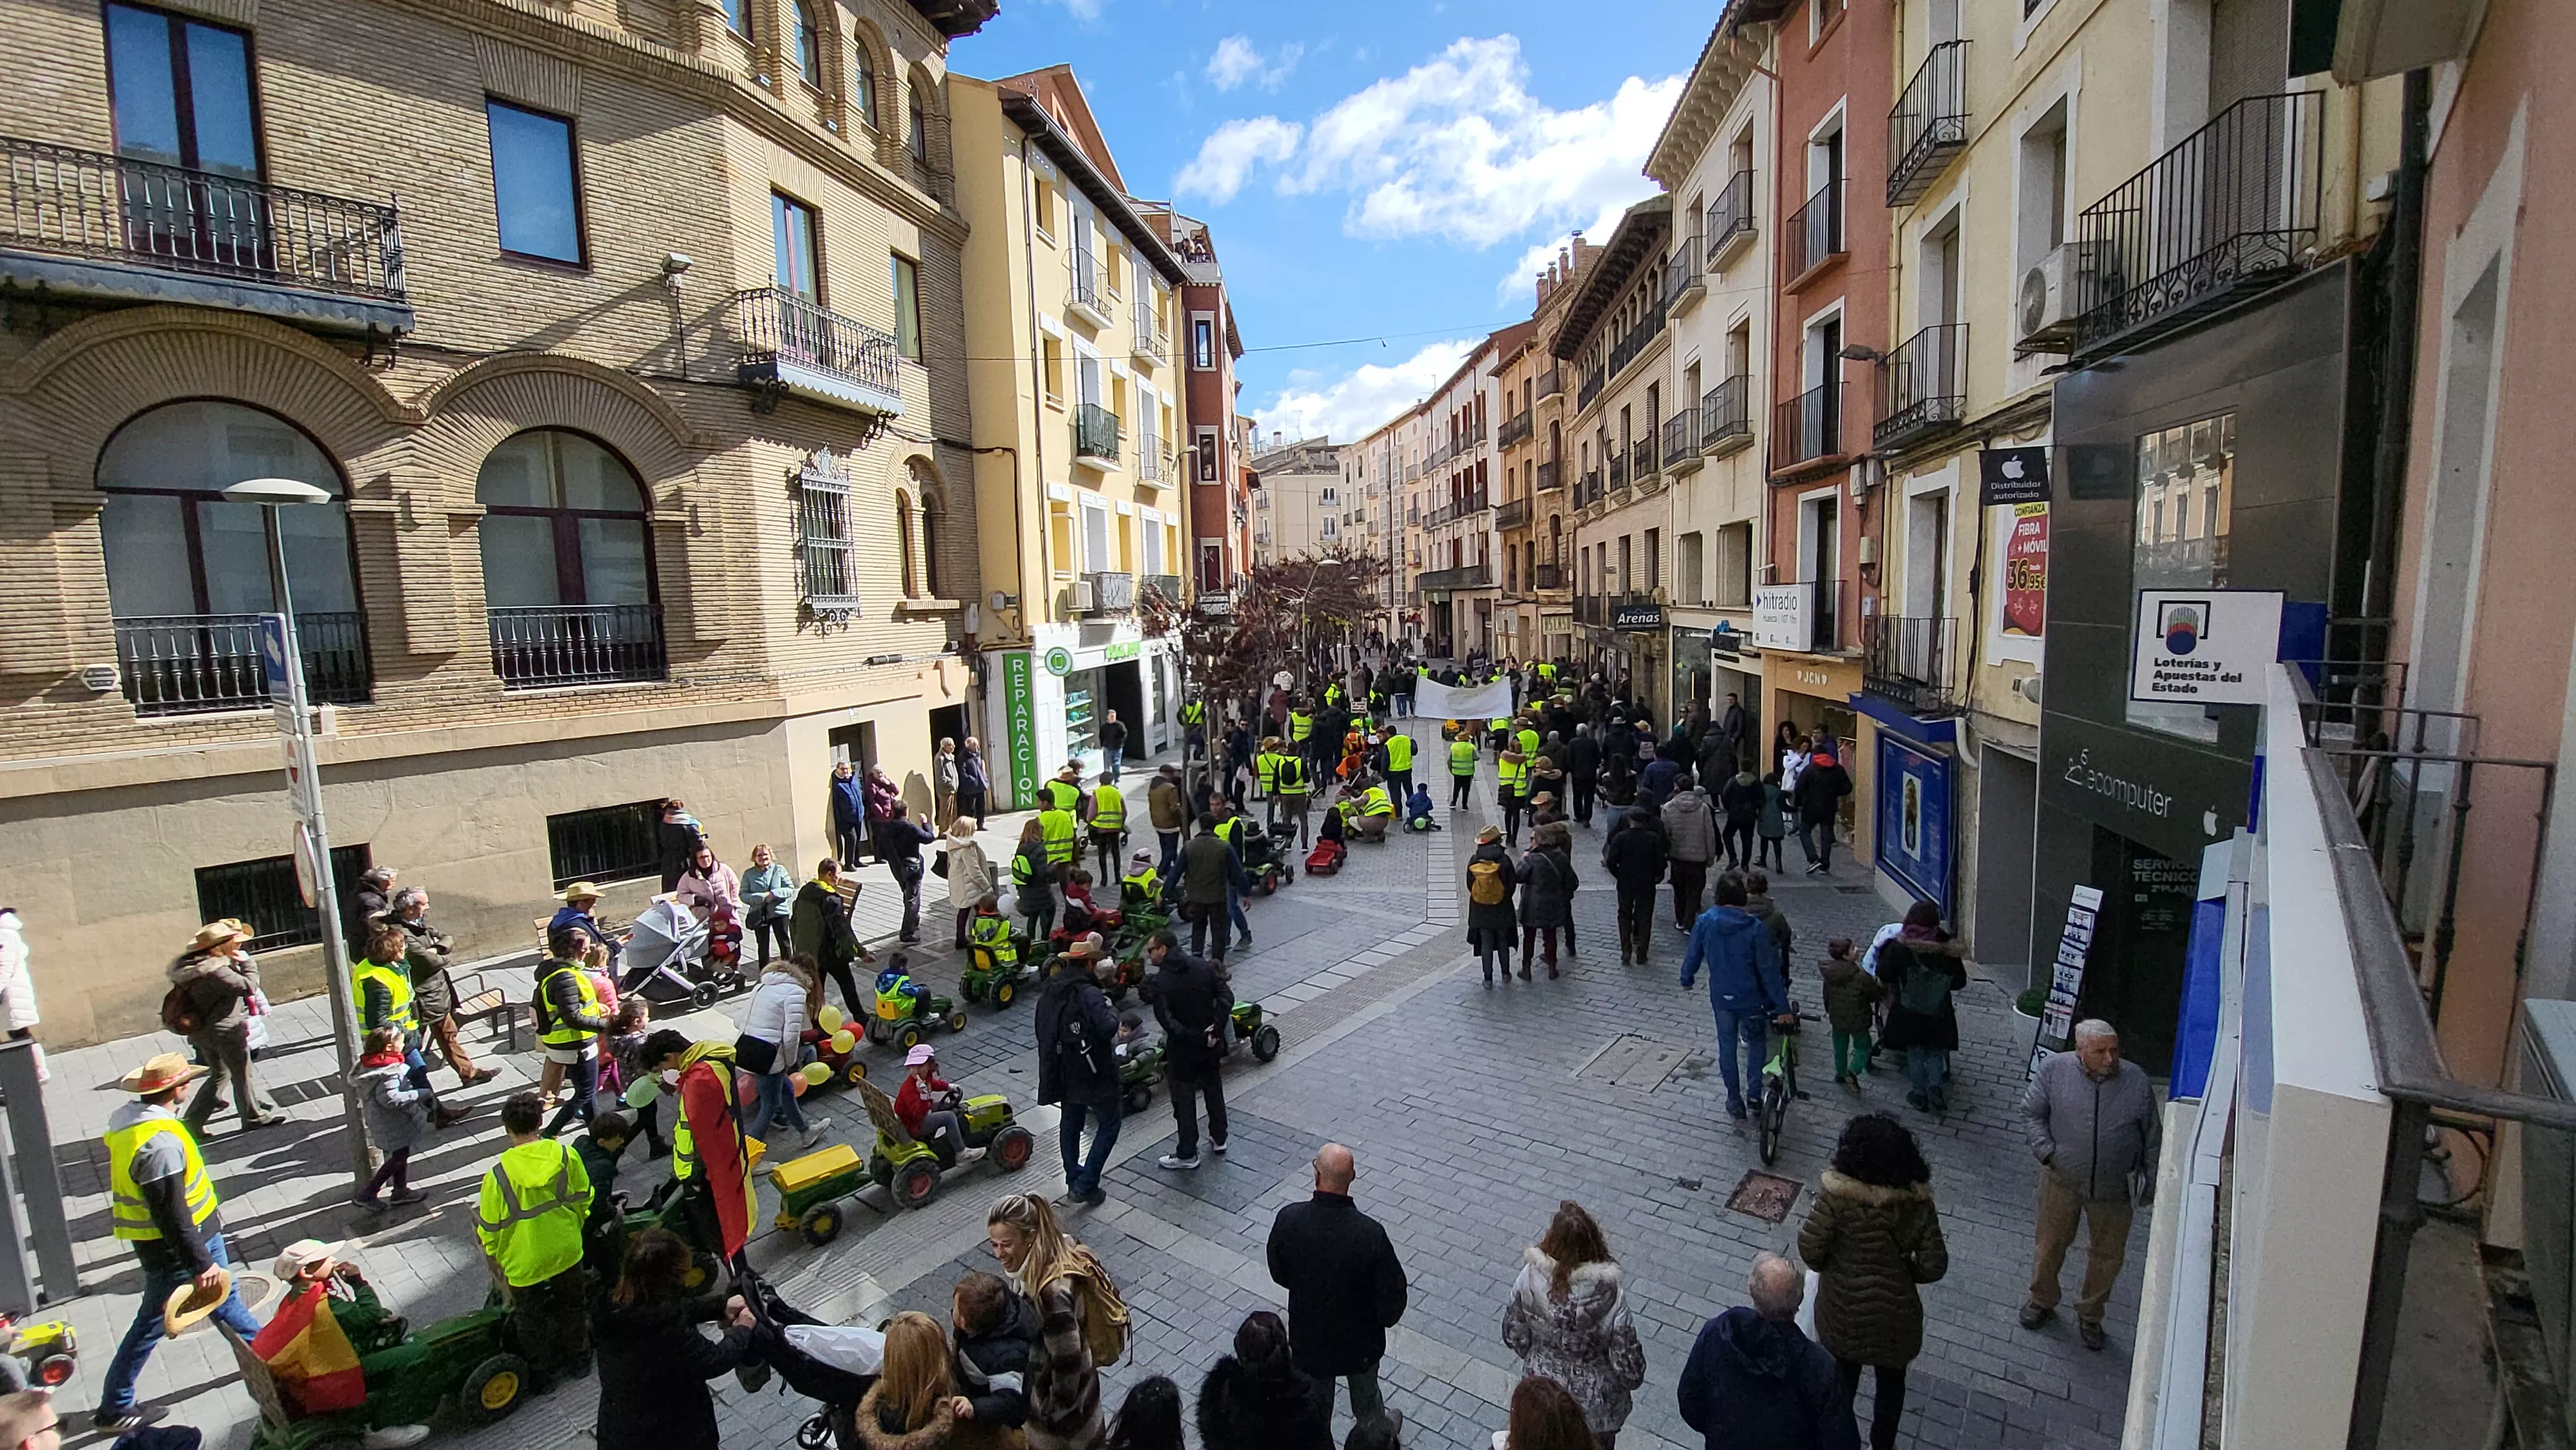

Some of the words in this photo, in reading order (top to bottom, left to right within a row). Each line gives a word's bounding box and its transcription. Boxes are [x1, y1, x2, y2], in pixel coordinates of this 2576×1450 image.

[1991, 481, 2041, 490] Distribuidor
[1993, 491, 2040, 500] autorizado
[2014, 503, 2046, 517] CONFIANZA
[2018, 522, 2040, 536] FIBRA
[1763, 591, 1797, 610] hitradio
[1617, 613, 1660, 624] Arenas
[2154, 657, 2209, 668] Loterías
[2213, 661, 2221, 672] y
[2154, 670, 2216, 681] Apuestas
[2221, 672, 2242, 683] del
[2152, 683, 2198, 693] Estado
[1013, 659, 1033, 805] REPARACION
